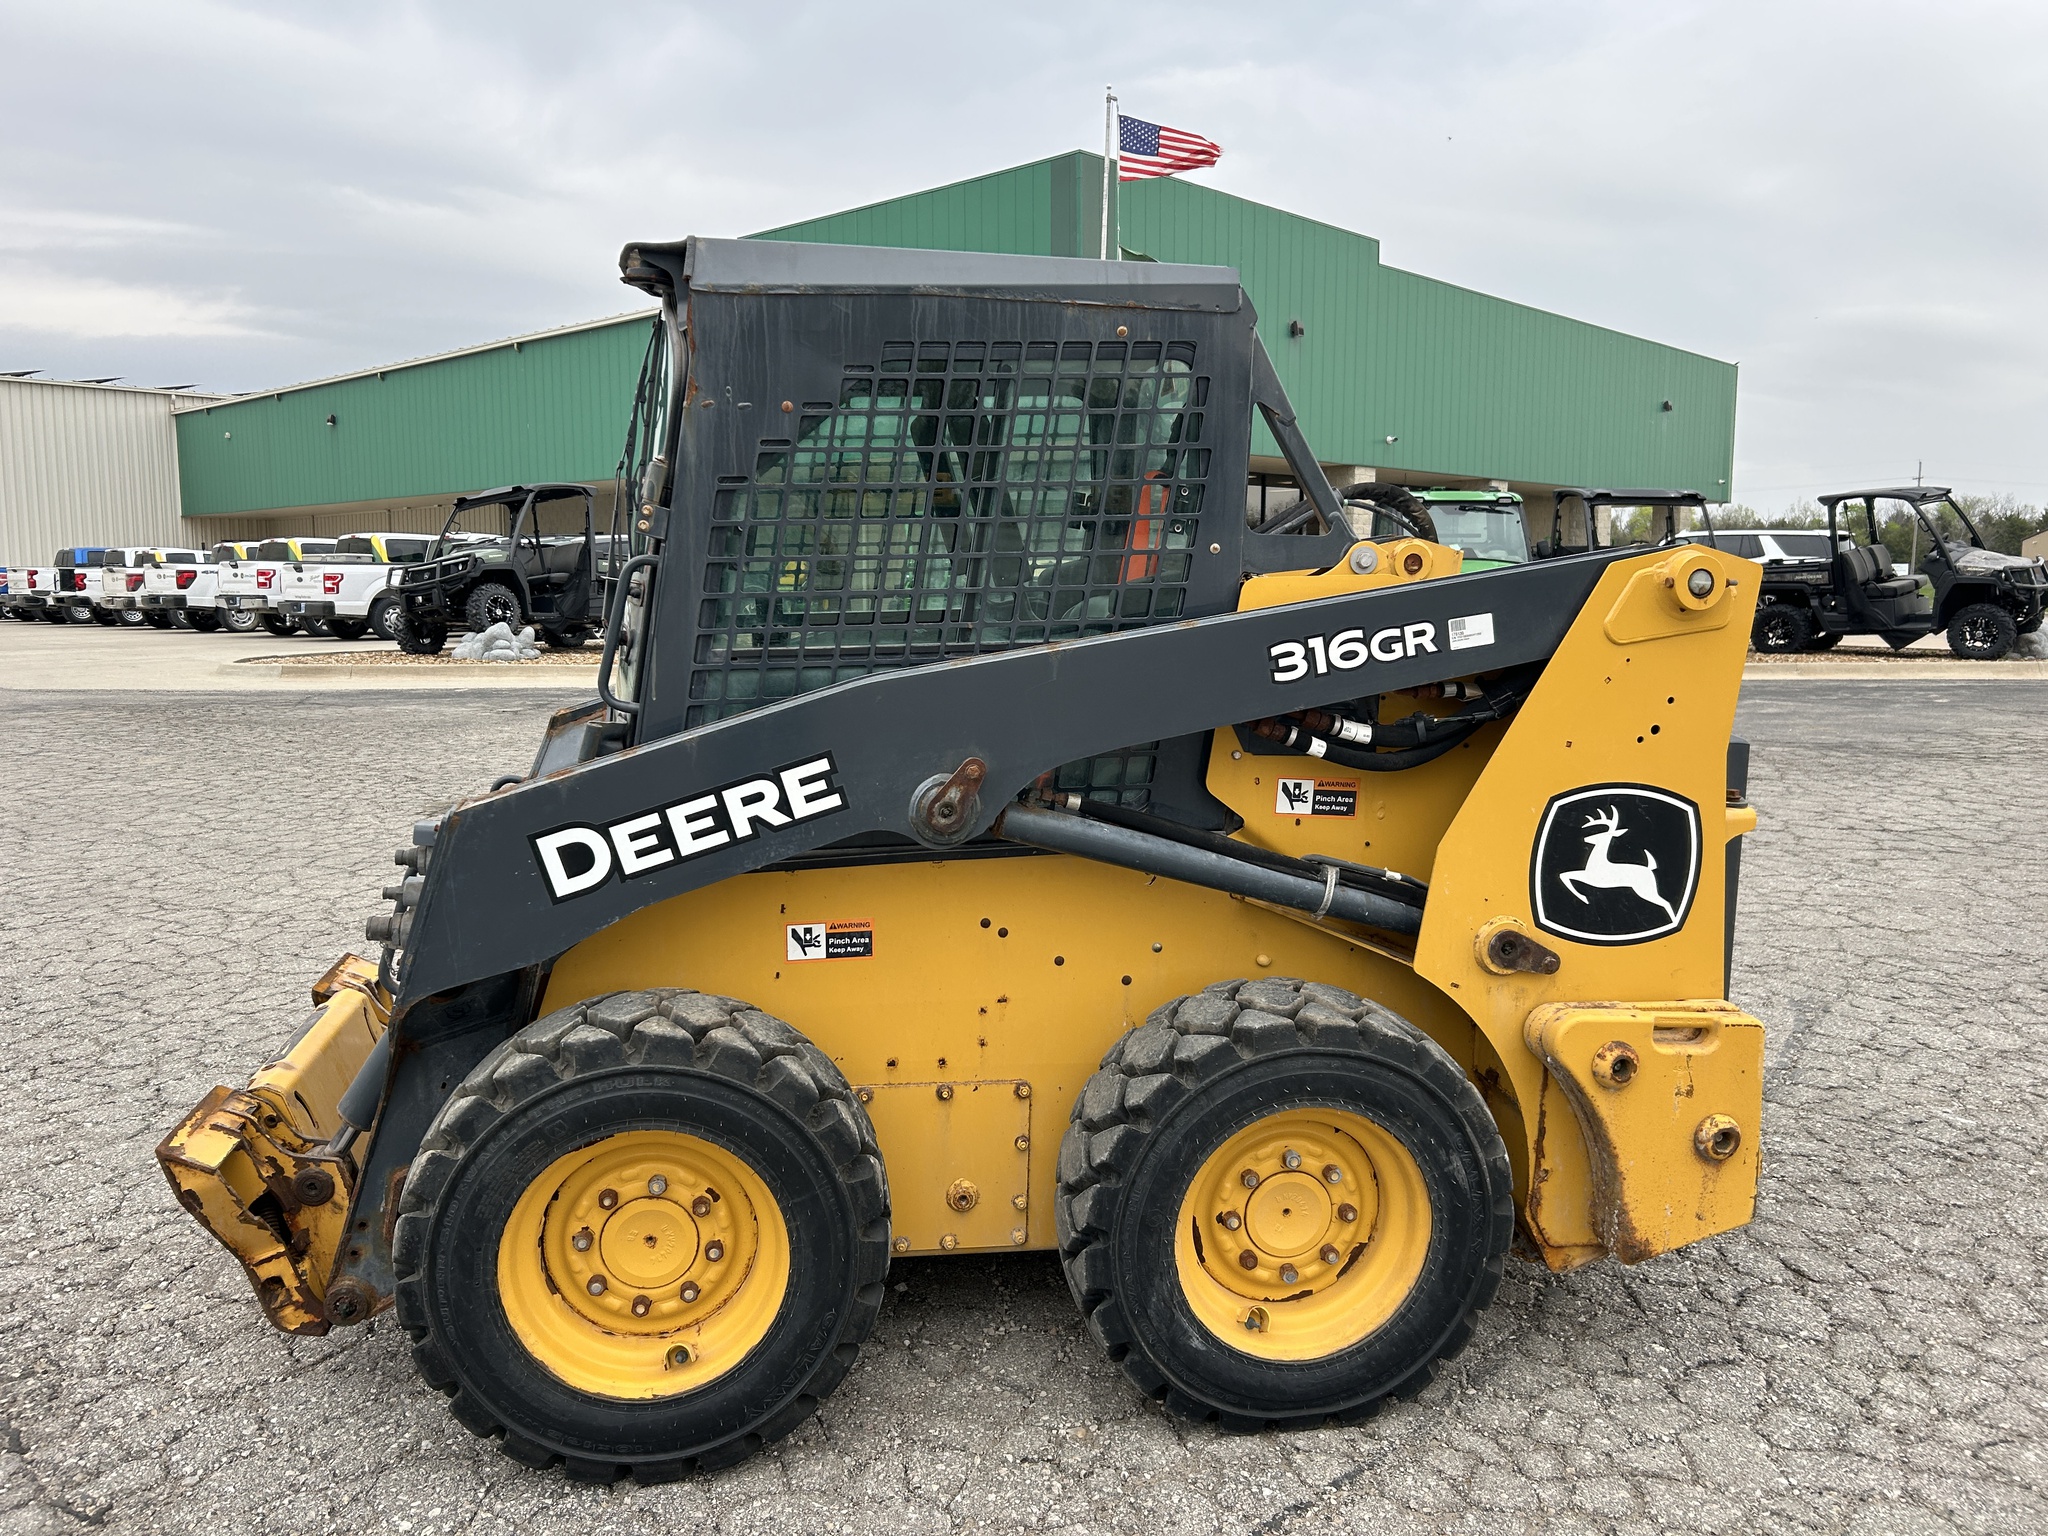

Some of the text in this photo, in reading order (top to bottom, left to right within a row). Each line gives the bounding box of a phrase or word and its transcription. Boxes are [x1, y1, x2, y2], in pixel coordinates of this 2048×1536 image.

[1269, 621, 1439, 683] 316GR
[1315, 794, 1336, 803] Pinch
[535, 757, 843, 898] DEERE
[836, 921, 871, 929] WARNING
[828, 935, 870, 945] Pinch Area
[590, 1076, 671, 1093] HULK
[741, 1309, 837, 1427] GALAXY
